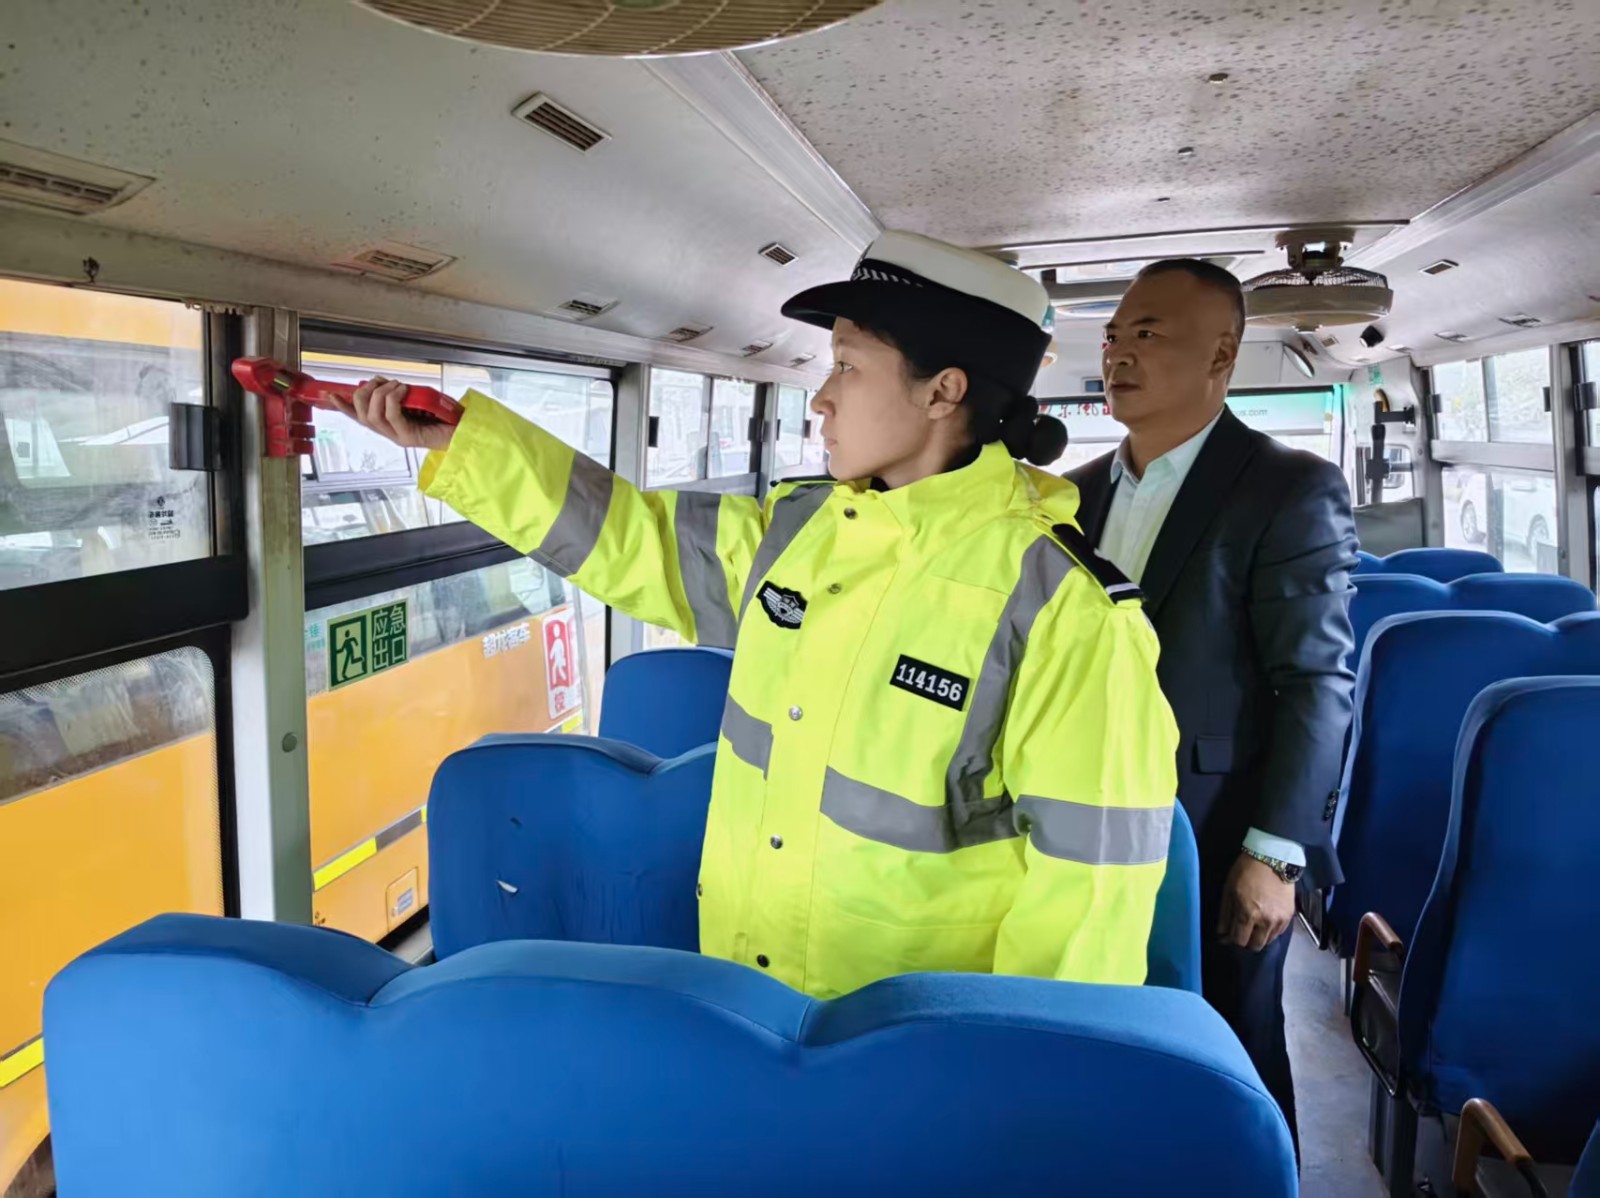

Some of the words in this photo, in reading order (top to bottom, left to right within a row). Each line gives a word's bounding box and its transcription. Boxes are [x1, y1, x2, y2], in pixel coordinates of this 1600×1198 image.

[373, 604, 406, 642] 应急
[373, 635, 406, 670] 出口
[896, 663, 963, 702] 114156
